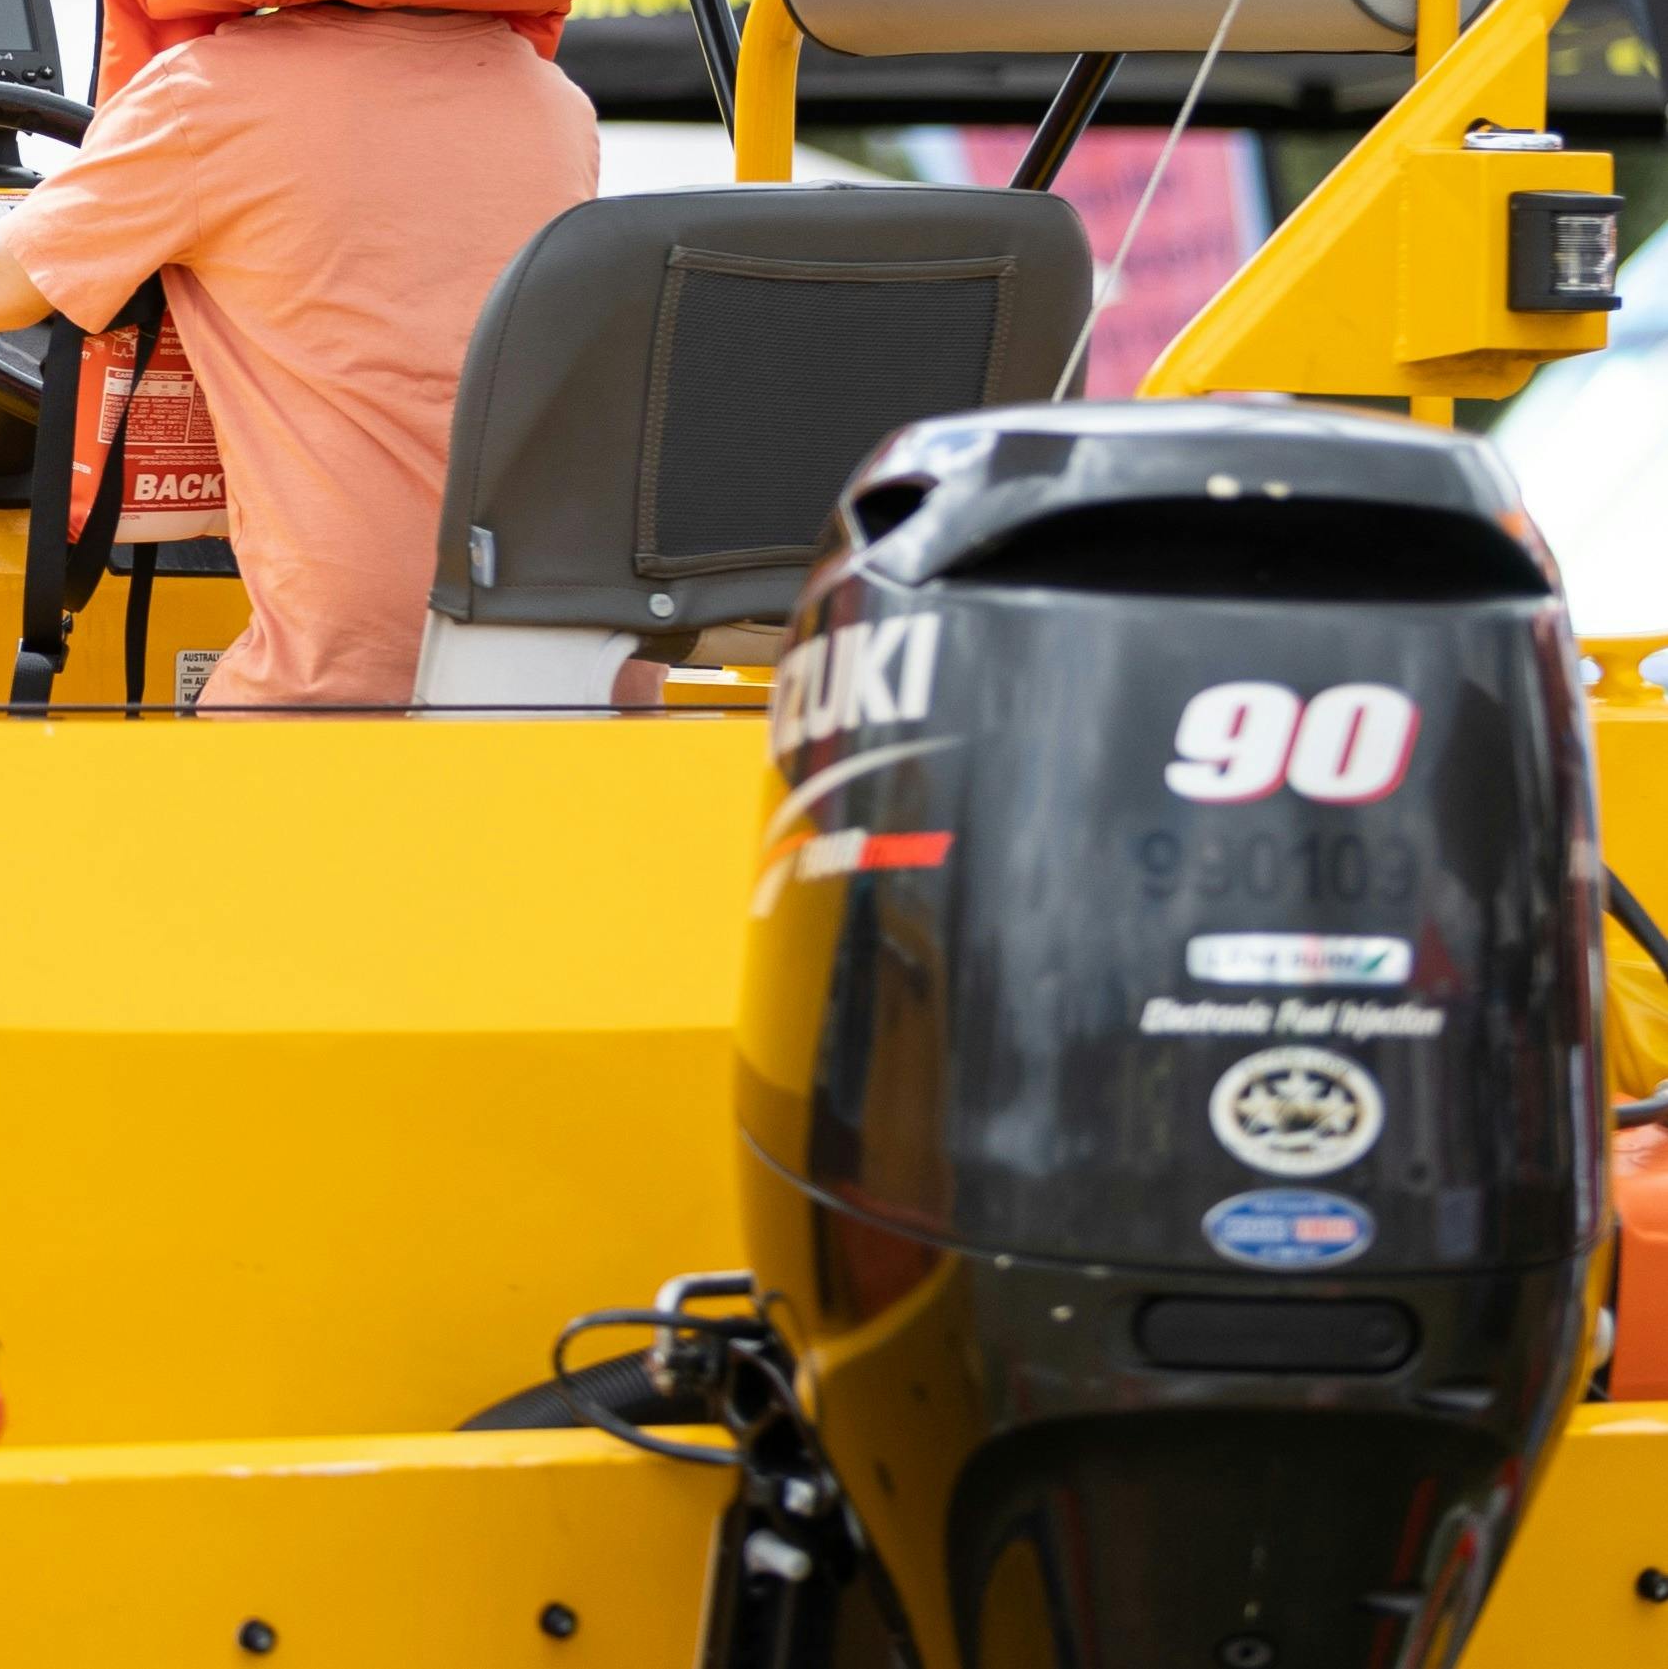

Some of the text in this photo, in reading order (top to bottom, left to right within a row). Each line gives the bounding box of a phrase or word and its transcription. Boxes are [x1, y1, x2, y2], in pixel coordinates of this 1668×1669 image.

[134, 473, 224, 500] BACK
[771, 613, 941, 756] ZUKI
[1165, 681, 1419, 804] 90
